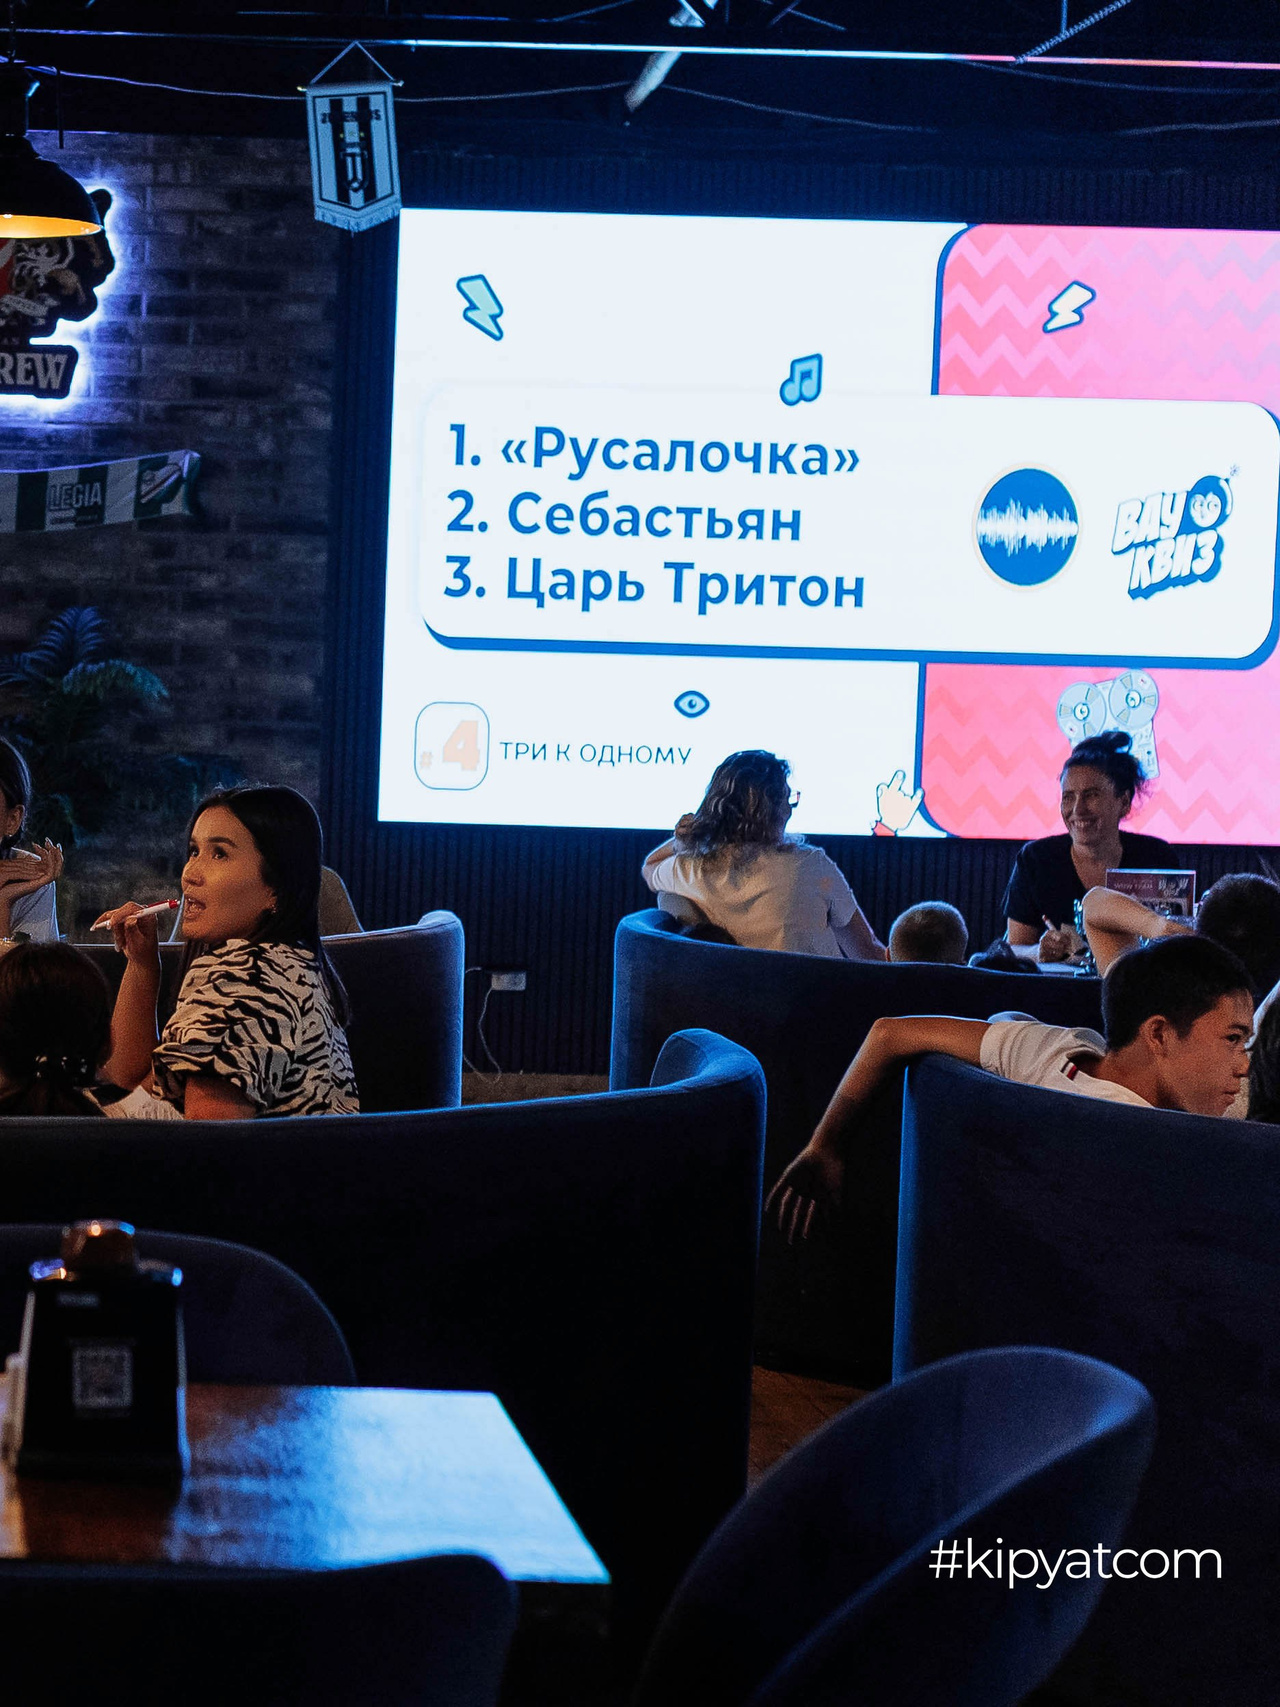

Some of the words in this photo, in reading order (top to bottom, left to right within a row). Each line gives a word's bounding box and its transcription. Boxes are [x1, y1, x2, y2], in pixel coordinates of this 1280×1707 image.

[449, 423, 481, 466] 1.
[501, 425, 860, 481] «Русалочка»
[49, 482, 103, 508] LEGIA
[446, 489, 489, 533] 2.
[507, 489, 802, 541] Себастьян
[1111, 490, 1188, 555] ВАУ
[443, 554, 486, 598] 3.
[507, 556, 646, 613] Царь
[663, 561, 866, 616] Тритон
[1128, 529, 1223, 598] КВИЗ
[499, 741, 547, 761] ТРИ
[556, 743, 571, 762] К
[580, 743, 692, 767] ОДНОМУ
